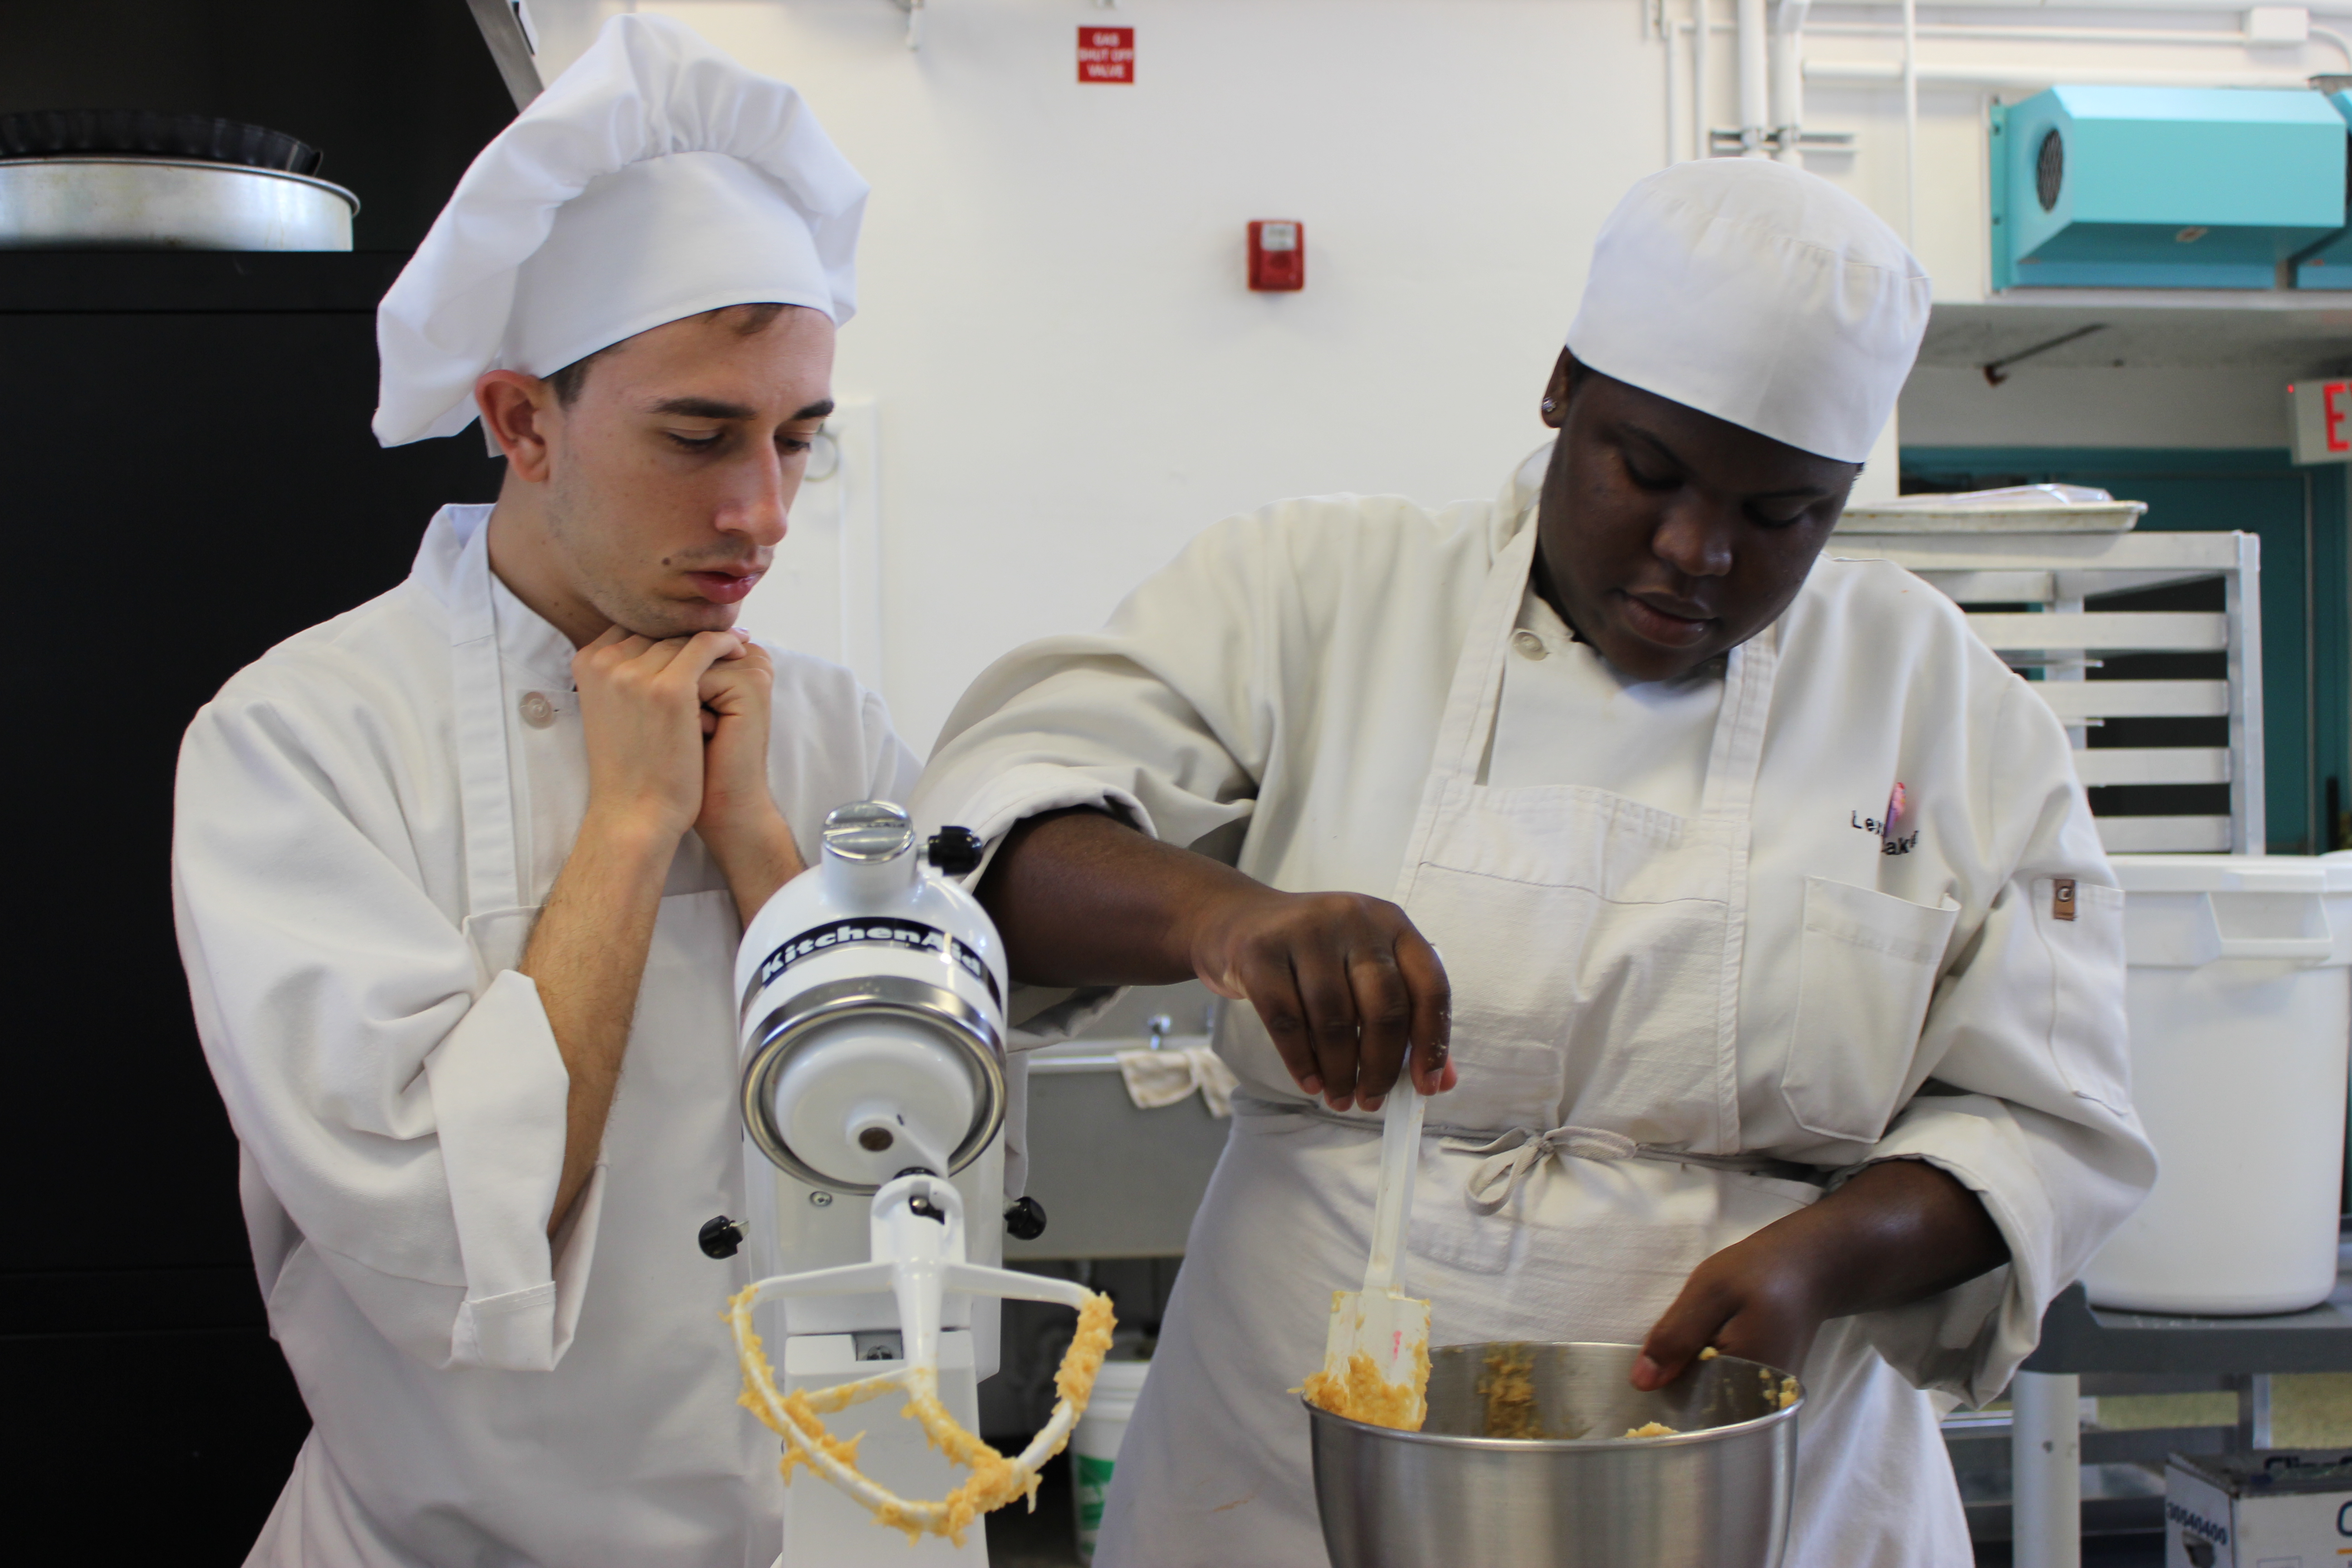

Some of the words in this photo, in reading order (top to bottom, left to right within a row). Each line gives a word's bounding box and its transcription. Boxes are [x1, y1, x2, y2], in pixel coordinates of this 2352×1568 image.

[1092, 32, 1120, 46] GAS
[1079, 48, 1108, 62] SHUT
[1110, 49, 1133, 62] OFF
[1087, 64, 1125, 78] VALVE
[2323, 383, 2352, 453] E
[762, 925, 981, 983] KitchenAid
